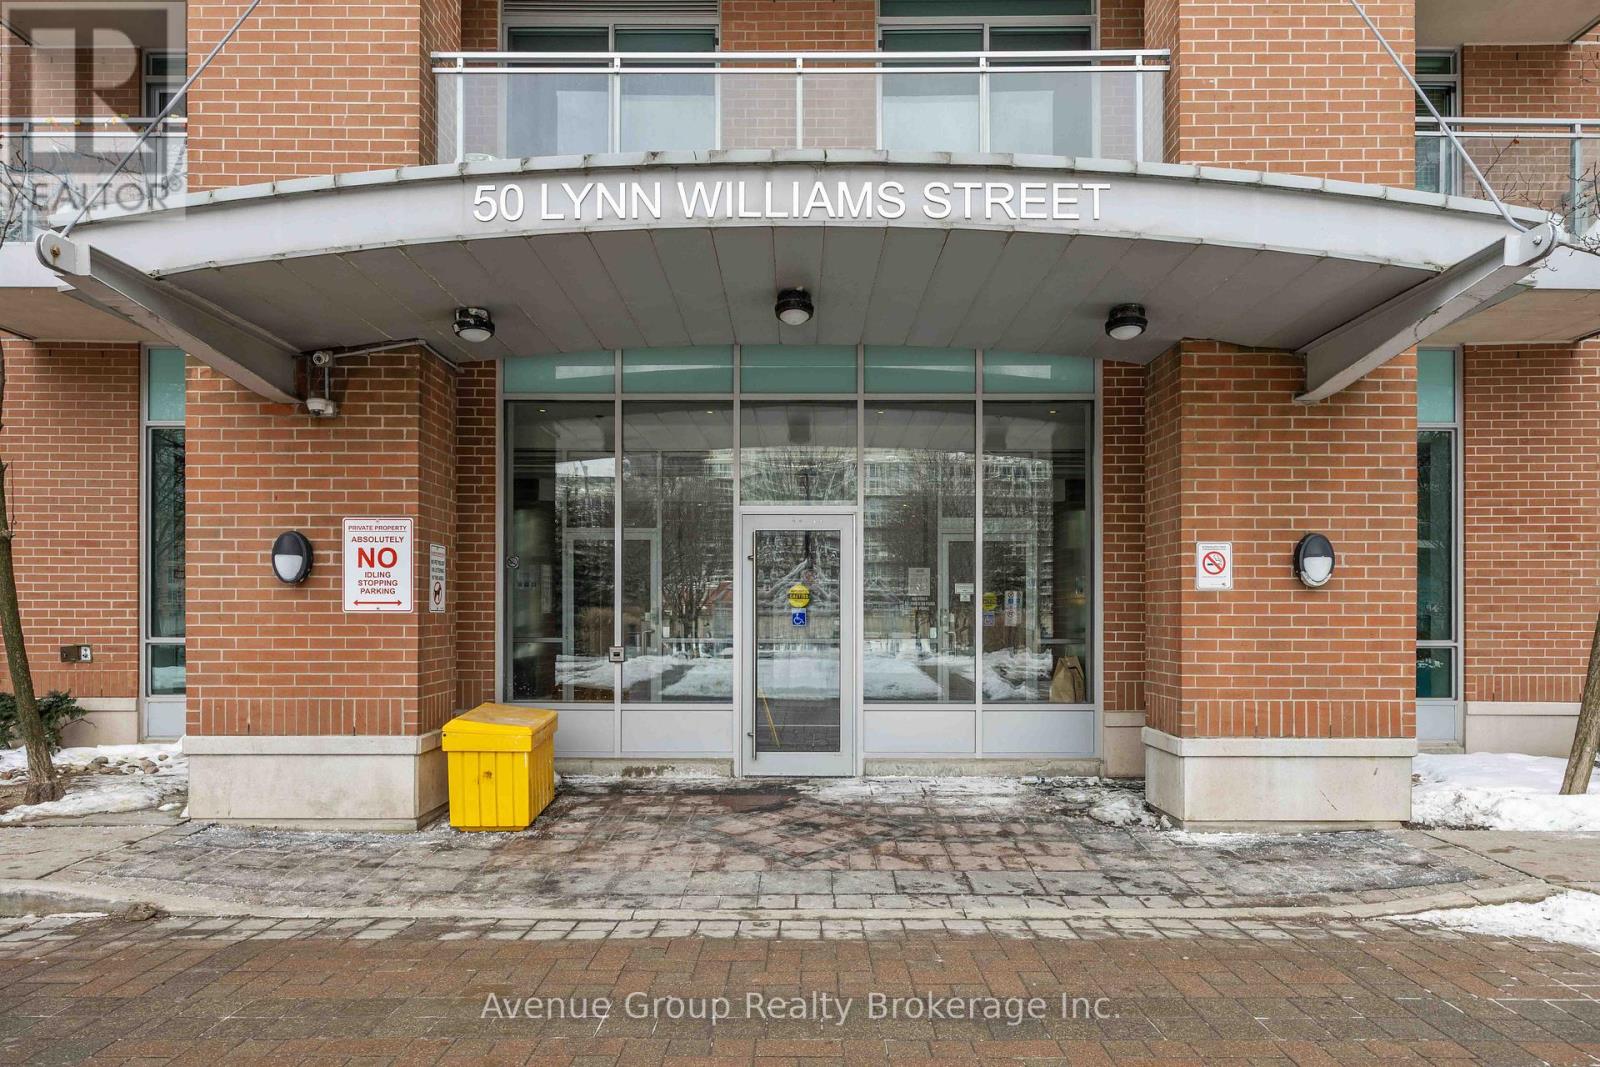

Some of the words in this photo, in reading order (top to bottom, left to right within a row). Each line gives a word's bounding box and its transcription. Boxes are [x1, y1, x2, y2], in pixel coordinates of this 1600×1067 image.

[472, 183, 525, 222] 50
[540, 181, 662, 220] LYNN
[677, 180, 907, 219] WILLIAMS
[922, 181, 1112, 220] STREET
[357, 547, 398, 569] NO
[364, 571, 392, 579] IDLING
